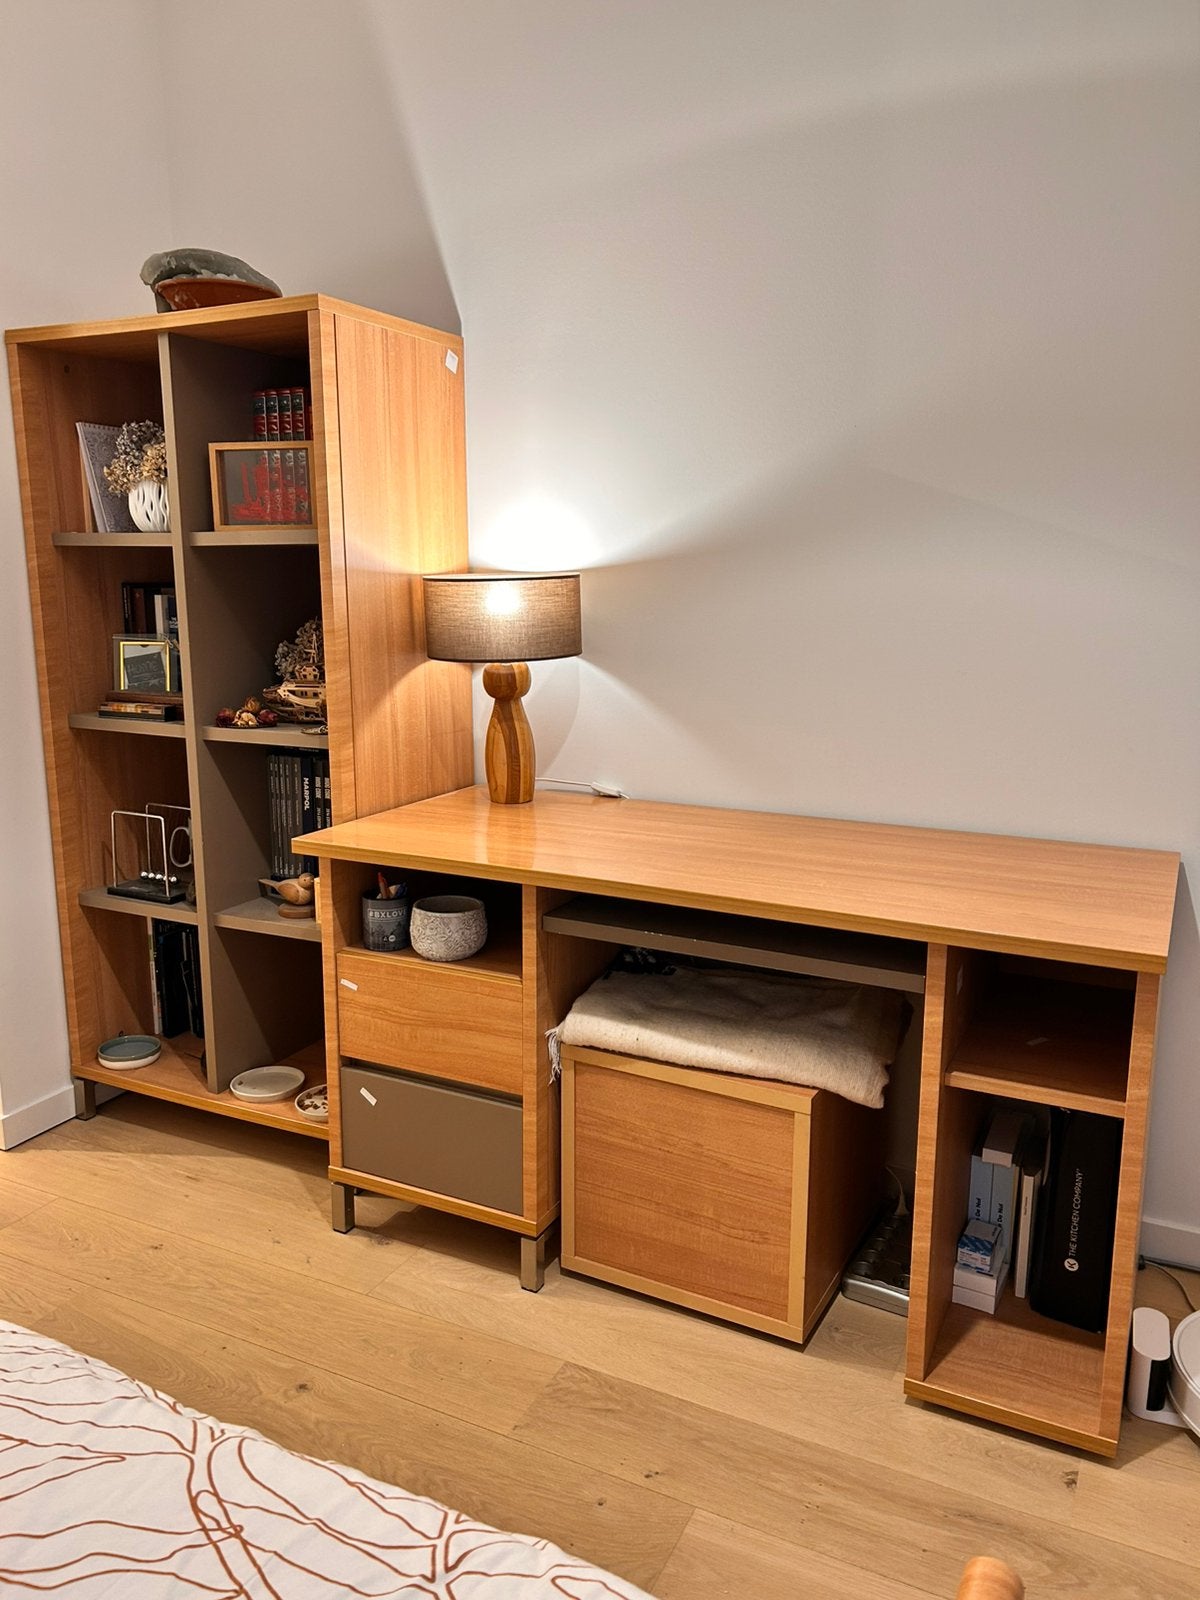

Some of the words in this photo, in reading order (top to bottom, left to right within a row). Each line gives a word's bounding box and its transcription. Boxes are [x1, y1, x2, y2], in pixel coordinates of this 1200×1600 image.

[1072, 1170, 1083, 1210] COMPANY
[1070, 1209, 1080, 1242] KITCHEN
[1069, 1242, 1077, 1256] THE
